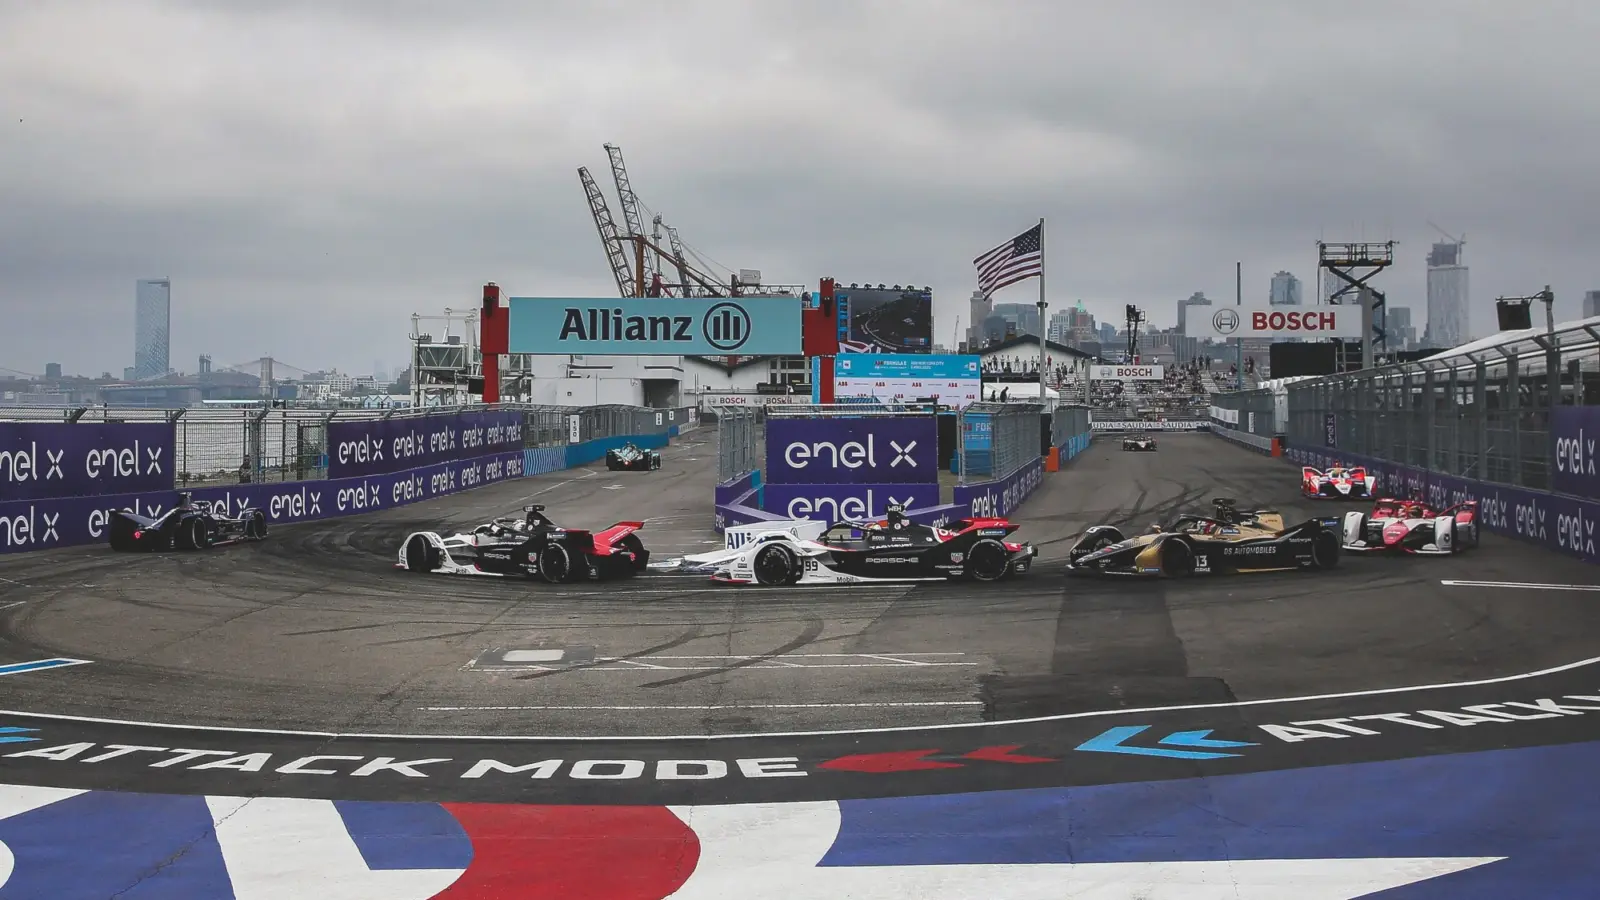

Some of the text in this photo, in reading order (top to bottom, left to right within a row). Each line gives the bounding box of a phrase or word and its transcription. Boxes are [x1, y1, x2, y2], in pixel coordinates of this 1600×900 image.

[559, 308, 693, 341] Allianz
[1252, 312, 1336, 330] BOSCH
[1117, 368, 1153, 377] BOSCH
[393, 429, 425, 459] enel x
[430, 425, 455, 453] enel x
[462, 423, 477, 448] enel
[487, 421, 500, 445] enel
[0, 441, 64, 482] nel x
[86, 440, 162, 479] enel x
[338, 433, 383, 464] enel x
[785, 433, 918, 468] enel x
[1556, 428, 1596, 476] enel x
[431, 466, 455, 494] enel x
[461, 461, 476, 486] enel
[486, 456, 498, 480] enel
[270, 486, 321, 519] enel x
[337, 480, 380, 511] enel x
[393, 473, 424, 503] enel x
[972, 488, 990, 518] enel
[787, 489, 874, 522] enel
[1481, 492, 1500, 527] enel
[1515, 498, 1547, 540] enel x
[0, 505, 60, 546] nel x
[1557, 507, 1595, 555] enel x
[483, 552, 511, 560] PORSCHE
[1195, 555, 1207, 567] 13
[1224, 546, 1276, 555] DS AUTOMOBILES
[805, 561, 818, 571] 99
[1258, 698, 1584, 742] ATTACK
[1, 742, 808, 780] ATTACK MODE
